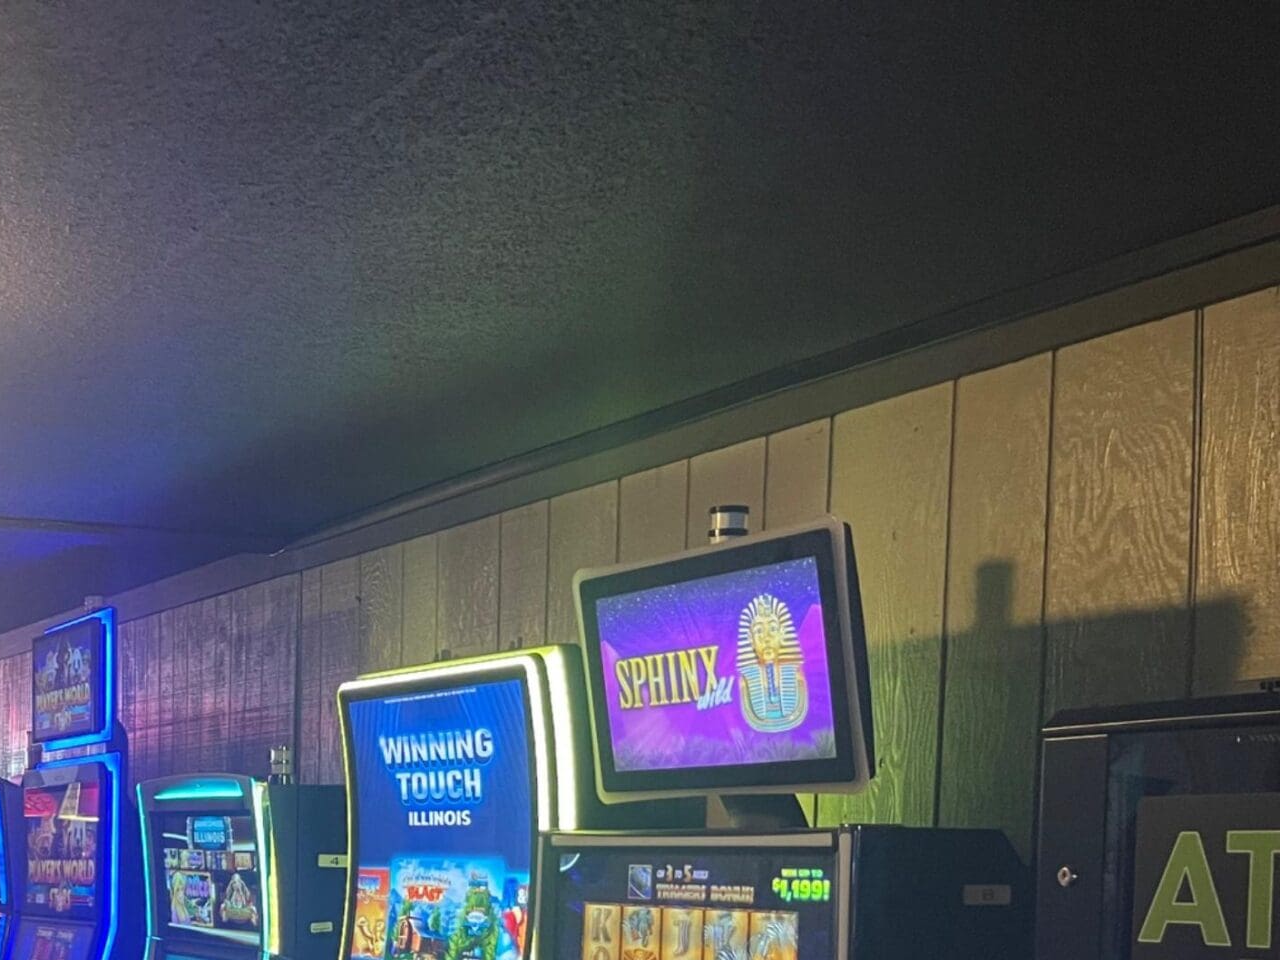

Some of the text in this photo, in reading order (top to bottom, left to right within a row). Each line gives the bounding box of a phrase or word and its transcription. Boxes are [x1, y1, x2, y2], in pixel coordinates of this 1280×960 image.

[616, 645, 718, 709] SPHINX
[36, 681, 91, 711] PLAYER'S WORLD
[379, 728, 494, 766] WINNING
[395, 768, 481, 801] TOUCH
[408, 809, 471, 826] ILLINOIS
[28, 859, 95, 883] PLAYER'S WORLD
[407, 884, 444, 902] BLAST
[772, 877, 830, 902] $1,199!
